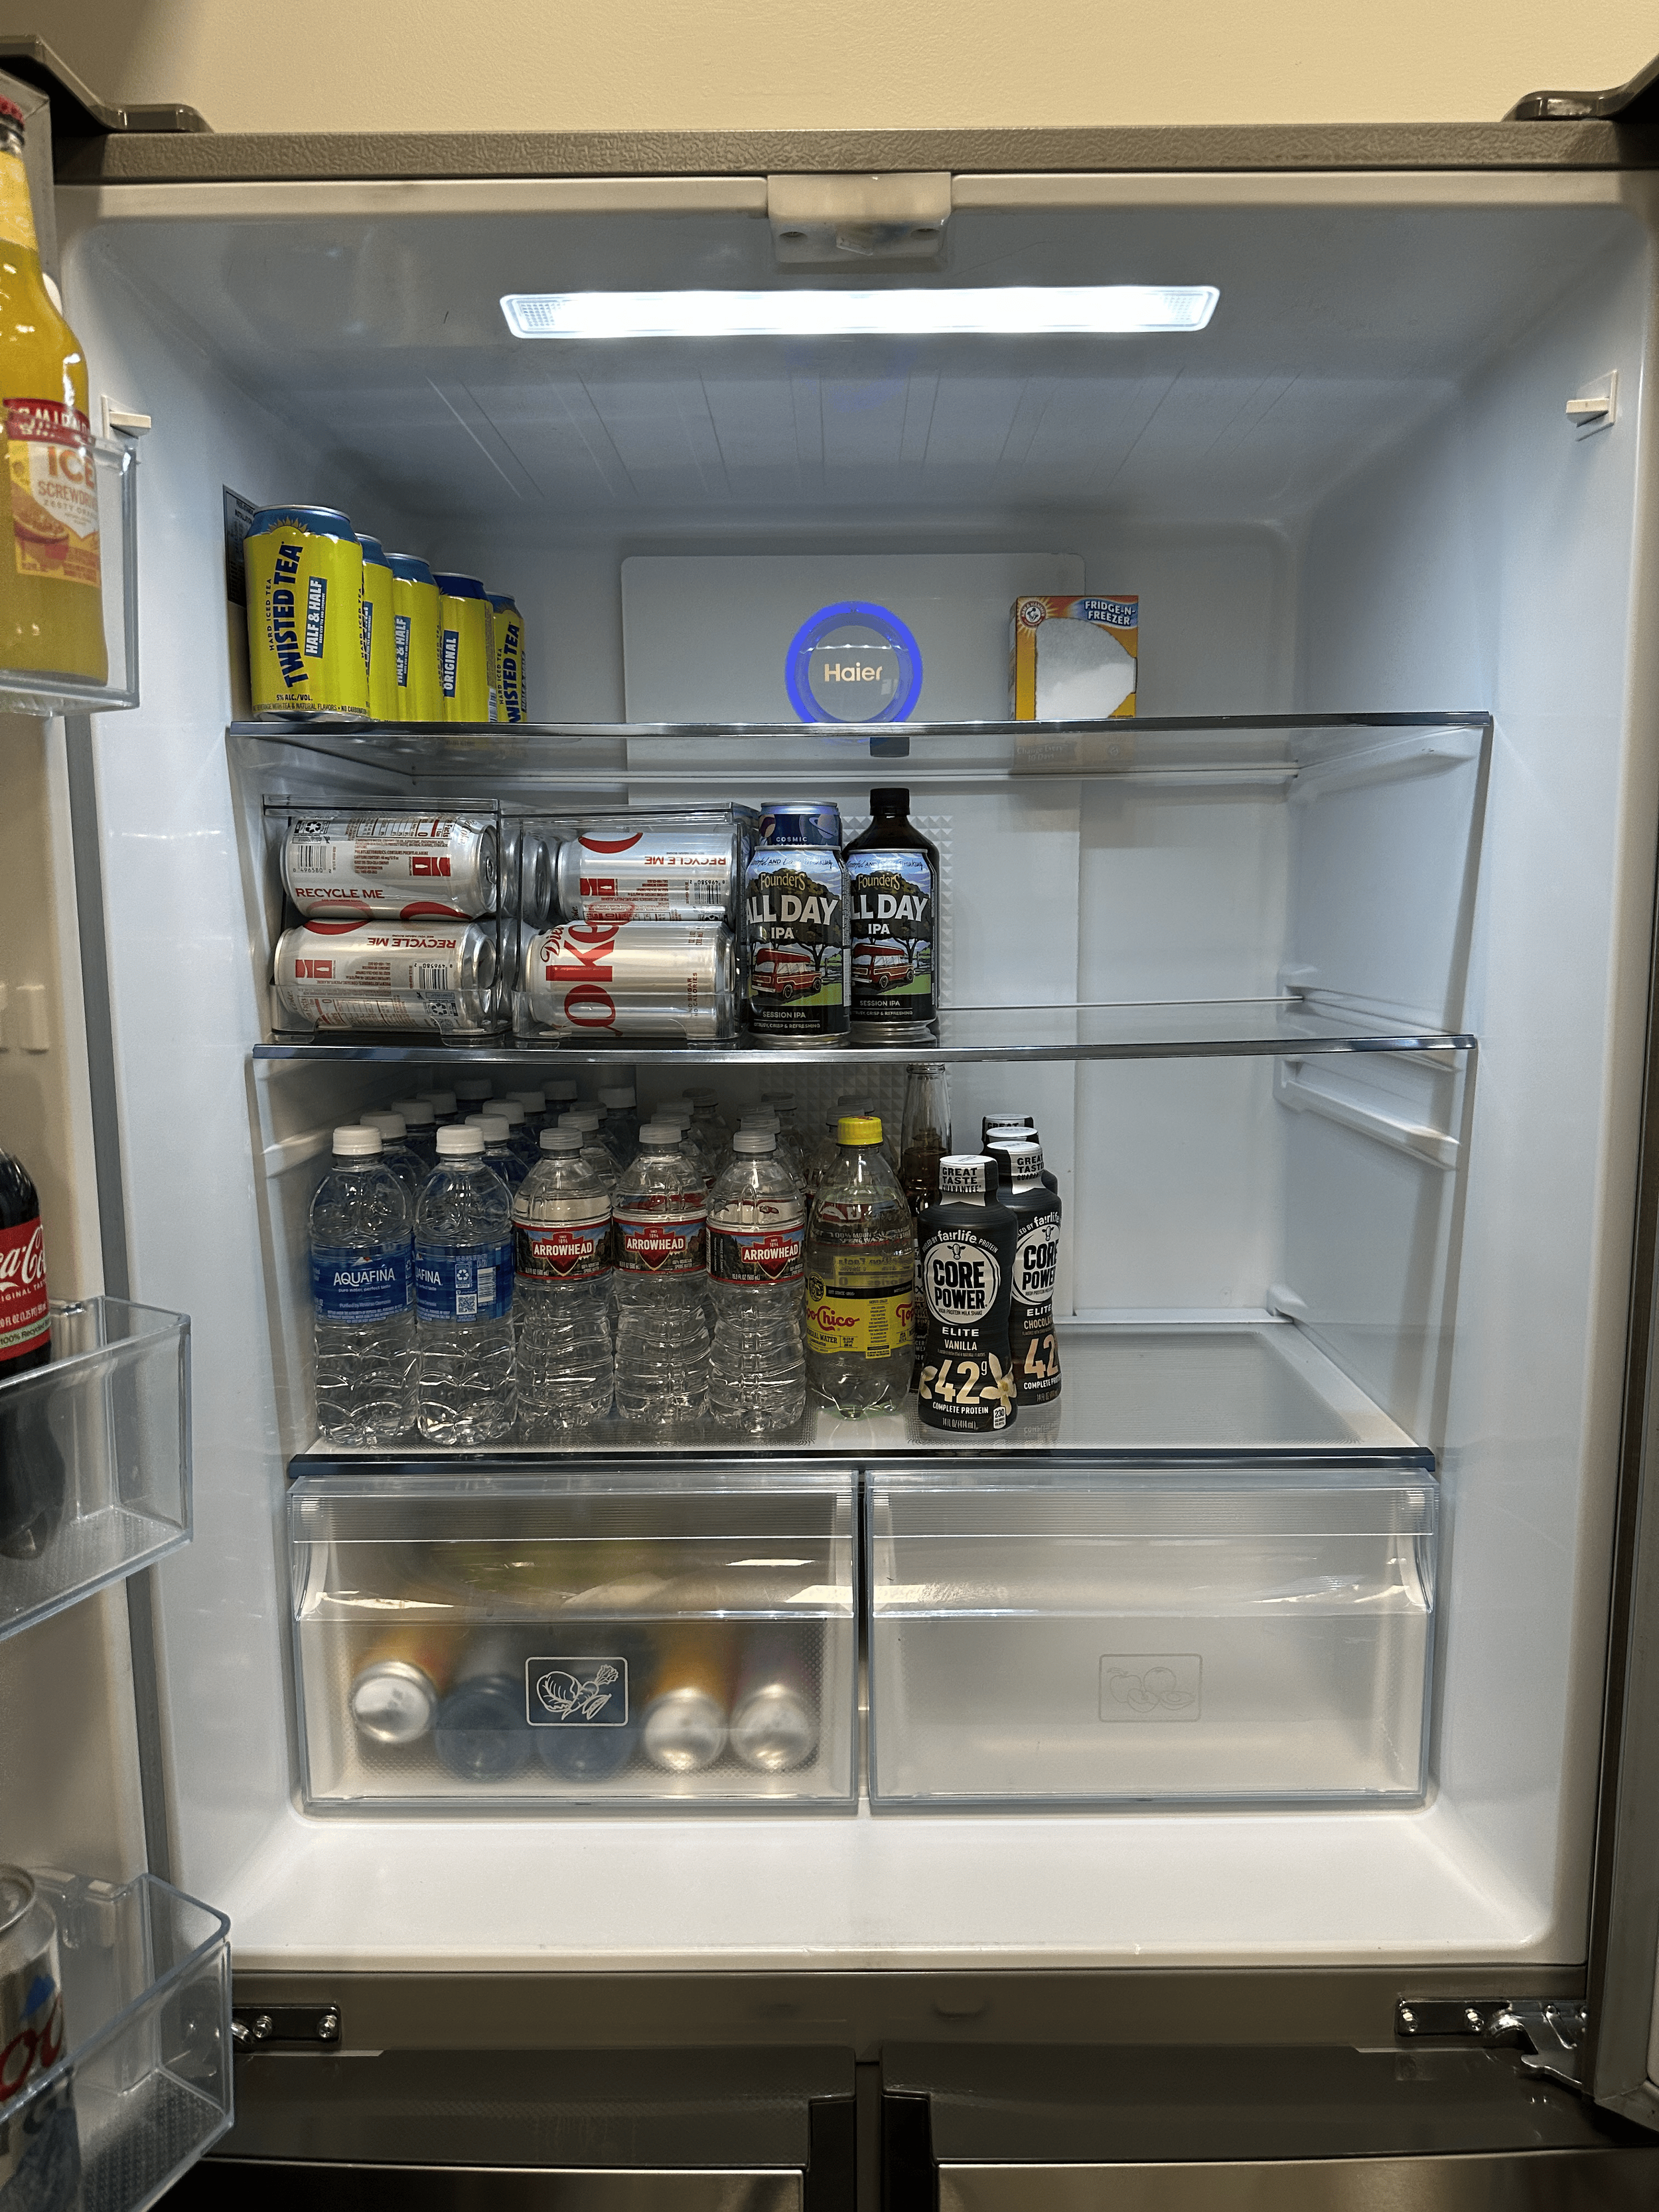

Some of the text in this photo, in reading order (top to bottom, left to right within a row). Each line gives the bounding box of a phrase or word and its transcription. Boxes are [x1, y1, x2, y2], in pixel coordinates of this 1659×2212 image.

[1085, 601, 1136, 615] FRIDGE-N-
[273, 544, 309, 688] TWISTED TEA
[306, 580, 322, 654] HALF & HALF
[1088, 611, 1131, 625] FREEZER
[396, 619, 406, 645] HALF
[396, 647, 404, 656] &
[443, 638, 457, 690] ORIGINAL
[503, 624, 520, 723] WISTED TEA
[824, 662, 883, 682] Haier
[644, 856, 726, 865] RECYCLE ME
[760, 873, 806, 891] Founders
[858, 875, 901, 891] Founders
[295, 888, 384, 899] RECYCLE ME
[747, 895, 776, 925] ALL
[781, 895, 838, 926] DAY
[851, 894, 928, 922] LL DAY
[771, 927, 794, 939] IPA
[868, 924, 890, 934] IPA
[367, 938, 457, 948] RECYCLE ME
[546, 921, 620, 1027] oke
[688, 1003, 693, 1012] NO
[693, 1008, 699, 1017] NO
[1017, 1153, 1043, 1165] GREAT
[942, 1167, 977, 1176] GREAT
[1017, 1228, 1026, 1237] LED
[1027, 1222, 1034, 1231] BY
[534, 1242, 593, 1256] ARROWHEAD
[626, 1238, 684, 1250] ARROWHEAD
[978, 1239, 999, 1254] PROTEIN
[744, 1244, 798, 1260] ARROWHEAD
[1023, 1239, 1059, 1271] CORE
[333, 1268, 396, 1287] AQUAFINA
[933, 1259, 985, 1289] CORE
[1022, 1266, 1056, 1290] POWE
[1, 1288, 31, 1302] IGINAL
[934, 1286, 985, 1309] POWER
[896, 1301, 914, 1327] Top
[1027, 1303, 1052, 1317] ELITE
[817, 1305, 861, 1331] Chico
[1023, 1317, 1052, 1330] CHOCOLA
[820, 1333, 837, 1344] WATER
[942, 1327, 979, 1337] ELITE
[1, 1334, 21, 1345] 100%
[944, 1339, 977, 1351] VANILLA
[1024, 1334, 1058, 1379] 42
[1024, 1378, 1051, 1390] COMPLETE
[932, 1401, 960, 1414] COMPLETE
[995, 1408, 1005, 1418] 230
[942, 1418, 947, 1426] 14
